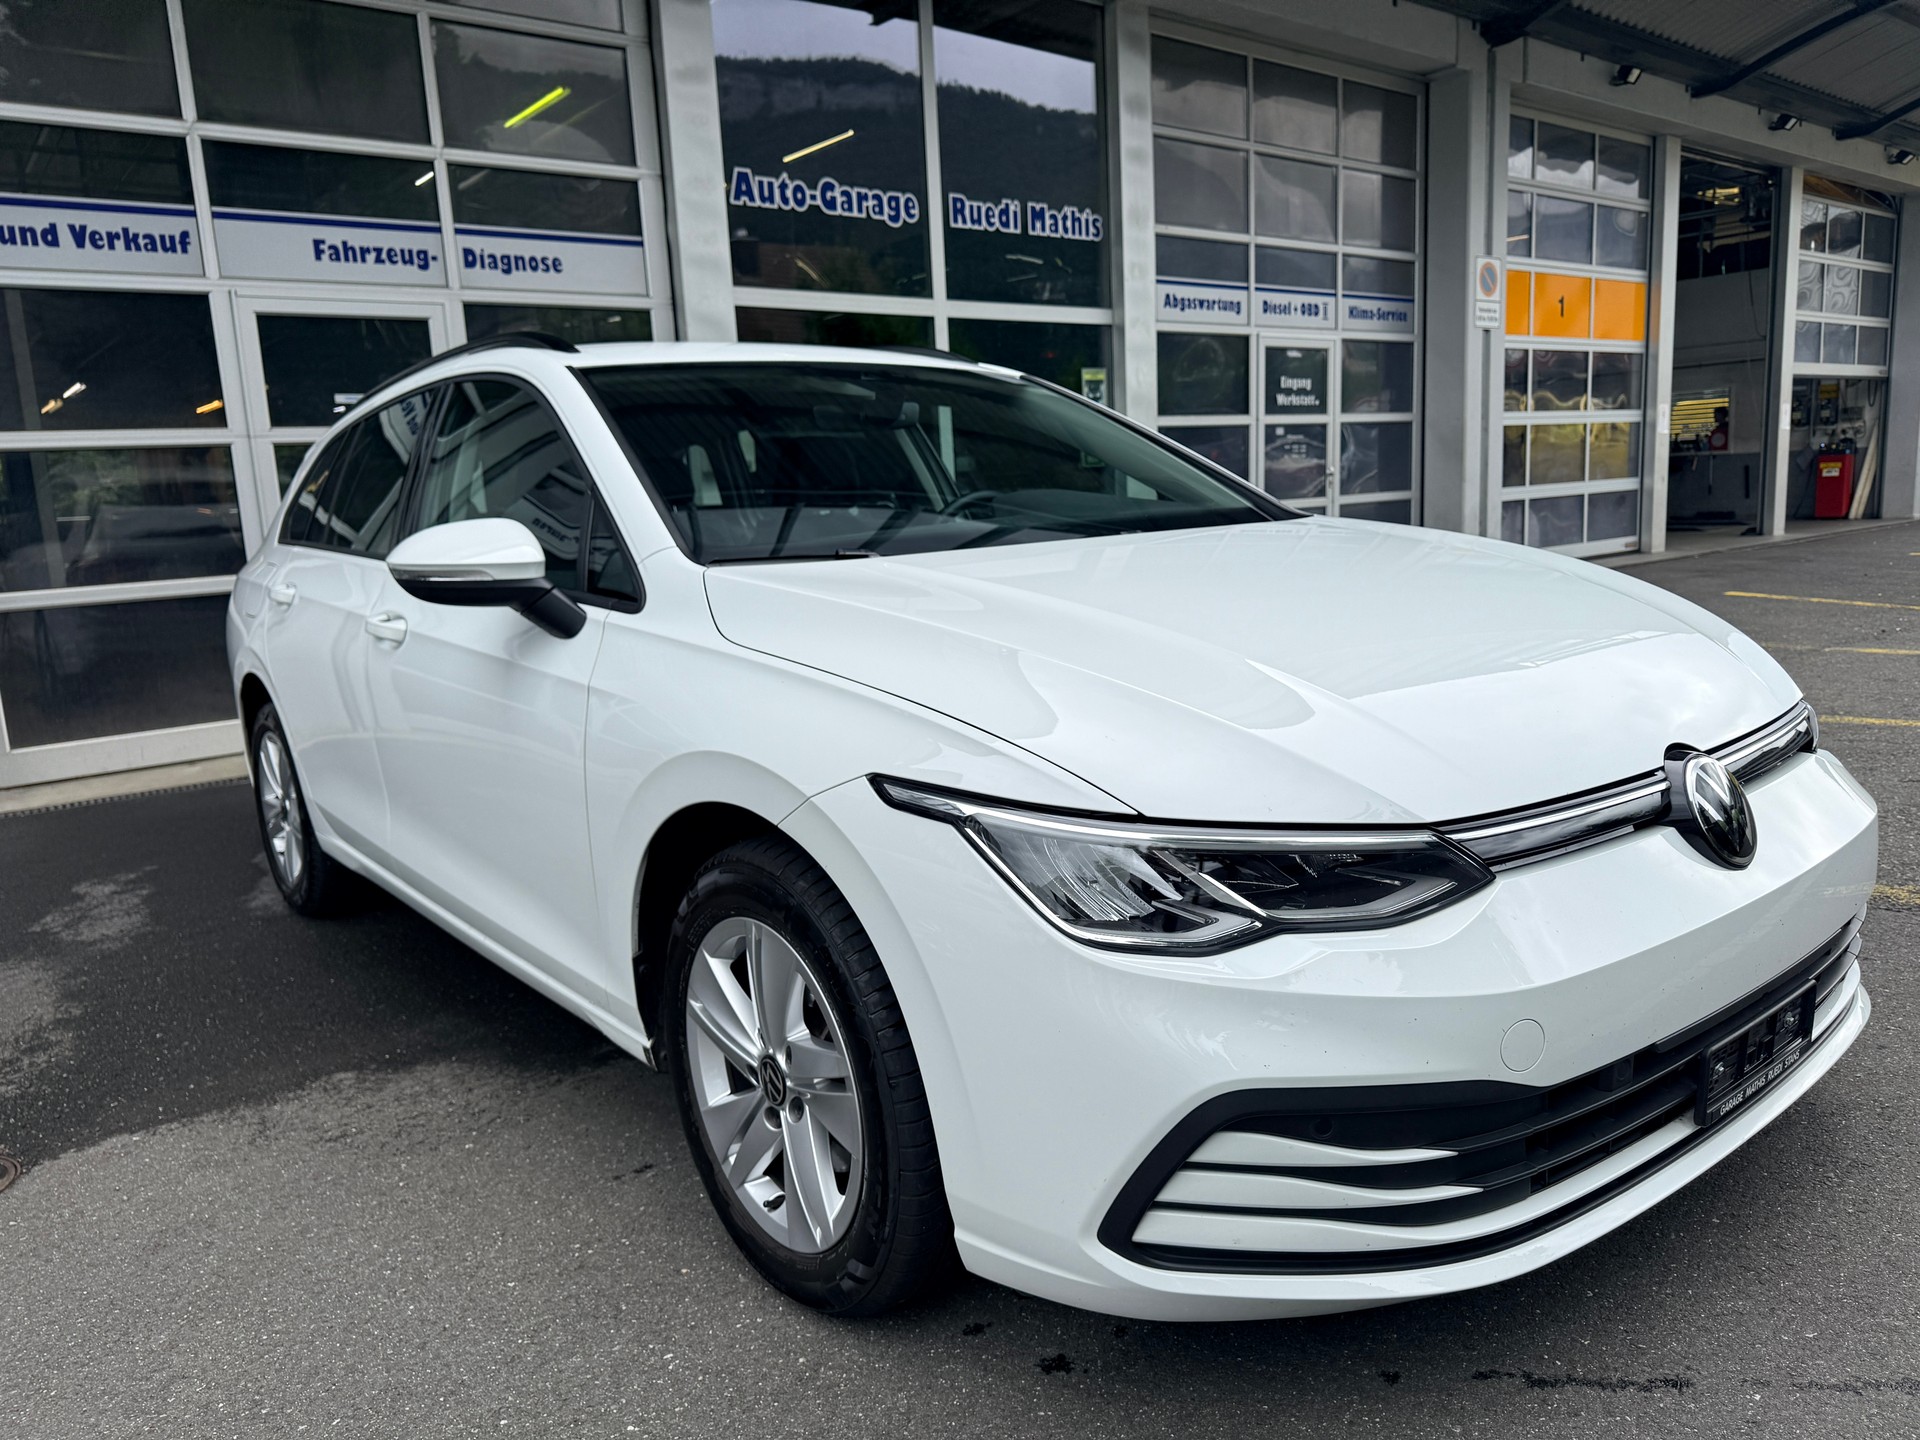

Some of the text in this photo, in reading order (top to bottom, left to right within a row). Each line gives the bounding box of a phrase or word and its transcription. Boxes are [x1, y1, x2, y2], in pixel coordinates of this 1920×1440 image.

[730, 166, 1103, 241] Auto-Garage Ruedi Mathis
[0, 222, 191, 254] und Verkauf
[312, 238, 563, 275] Fahrzeug- Diagnose
[1163, 293, 1242, 315] Abgaswartung
[1262, 300, 1292, 315] Diesel
[1300, 302, 1320, 317] OBD
[1348, 305, 1408, 322] Klima-Service
[1558, 294, 1565, 318] 1
[1280, 375, 1312, 391] Eingang
[1720, 1091, 1744, 1116] GARAGE
[1745, 1075, 1766, 1098] MATHIS
[1767, 1062, 1784, 1081] RUEDI
